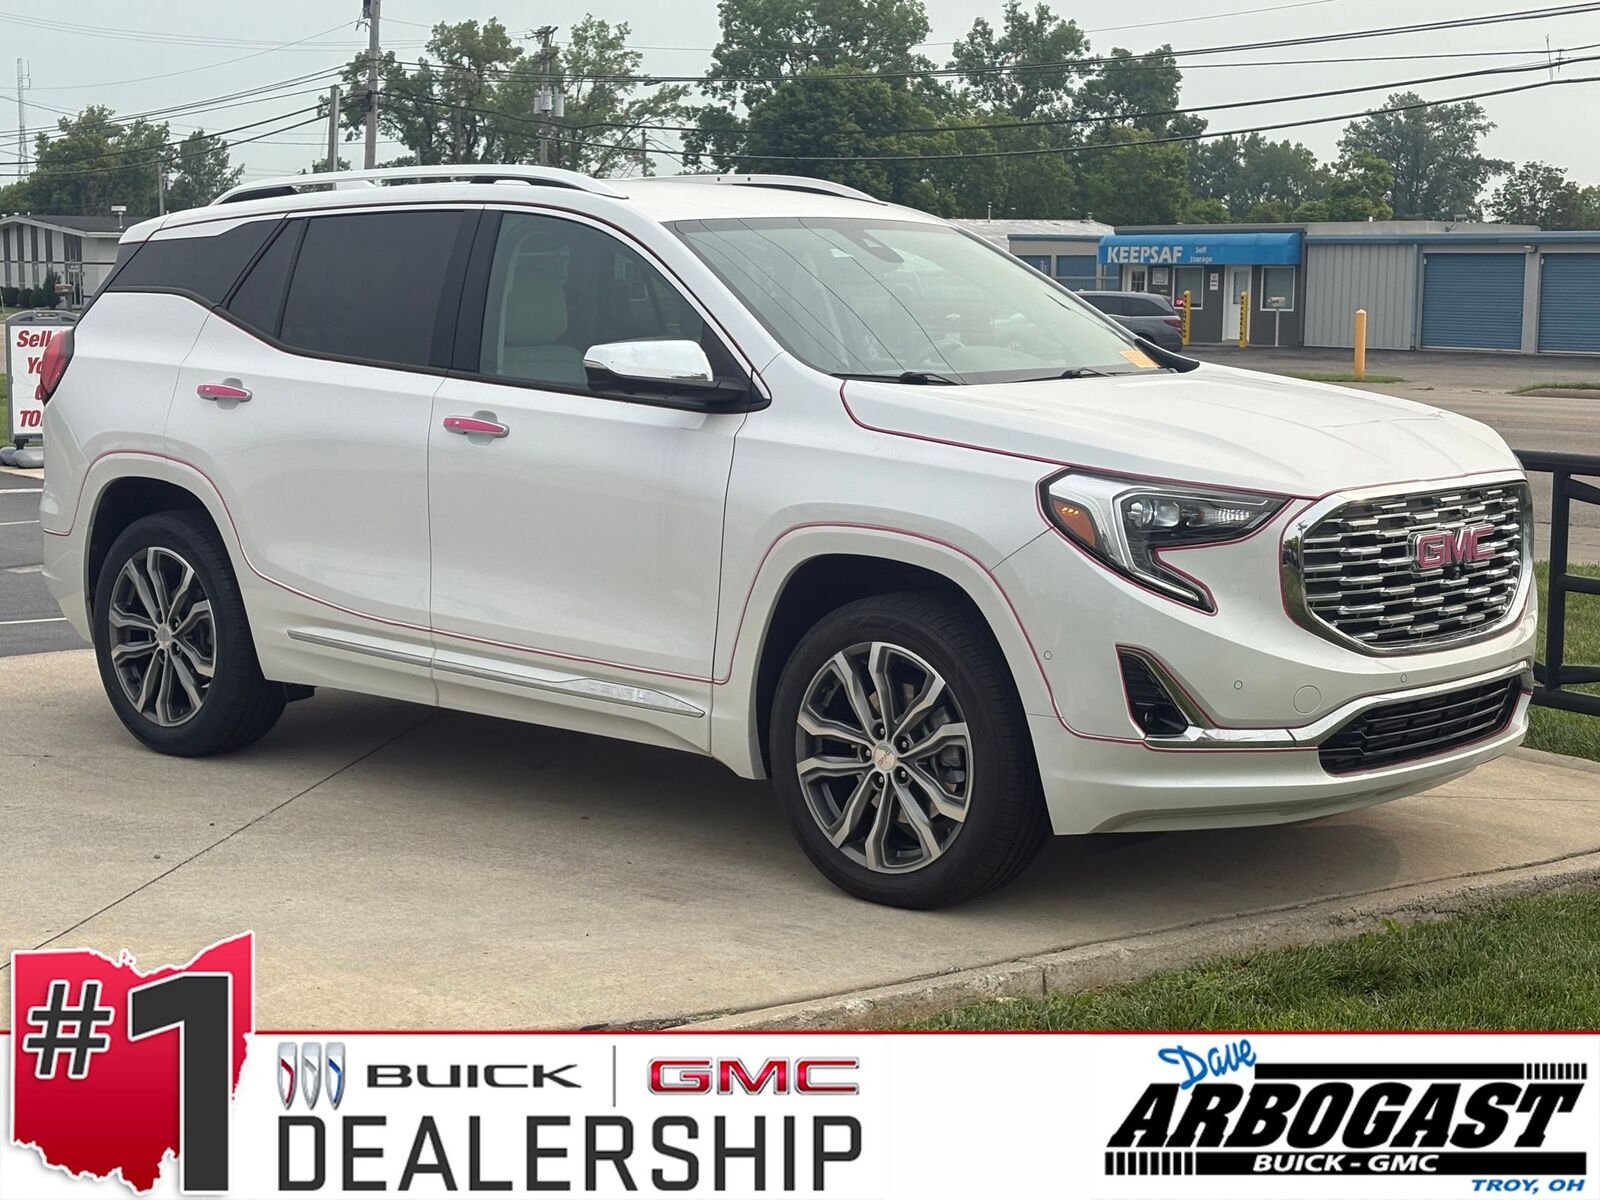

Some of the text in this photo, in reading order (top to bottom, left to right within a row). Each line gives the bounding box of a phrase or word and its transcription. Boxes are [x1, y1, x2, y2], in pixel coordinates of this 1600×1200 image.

[1107, 246, 1182, 264] KEEPSAF
[1195, 246, 1207, 254] Self
[16, 330, 52, 348] Sell
[1416, 523, 1495, 568] GMC
